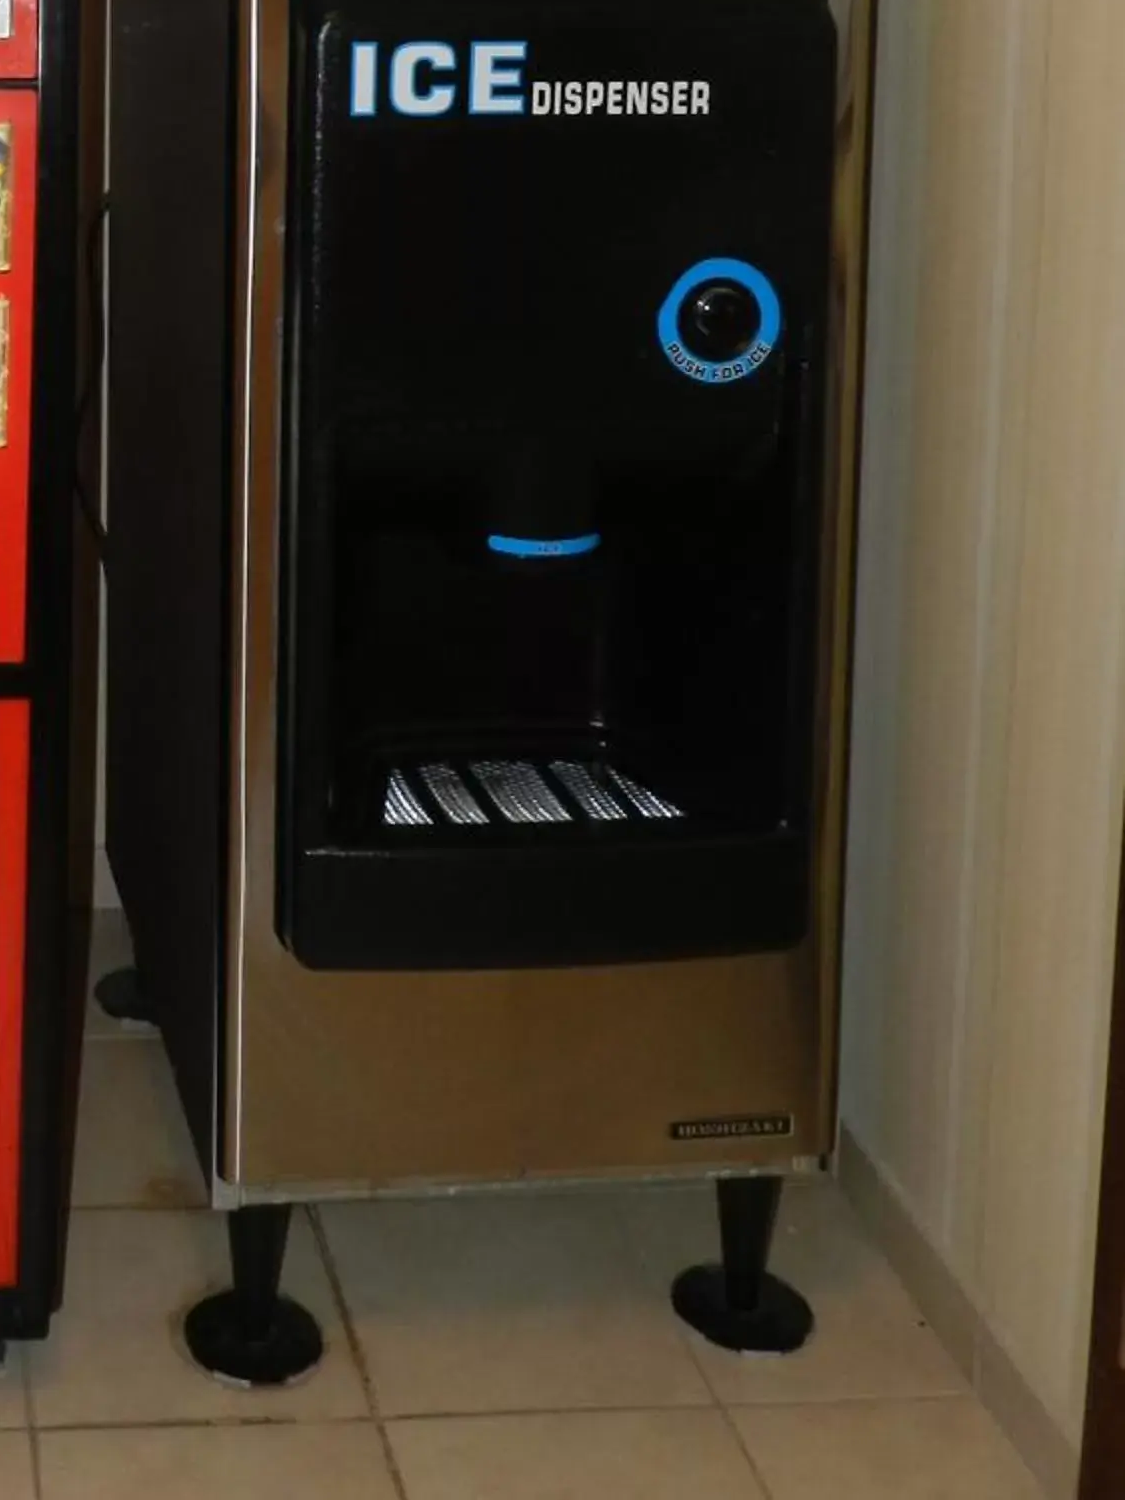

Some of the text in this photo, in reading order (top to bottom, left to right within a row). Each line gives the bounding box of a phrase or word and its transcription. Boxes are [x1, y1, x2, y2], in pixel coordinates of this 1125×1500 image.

[350, 41, 711, 117] ICE DISPENSER
[667, 343, 771, 379] PUSH FOR ICE
